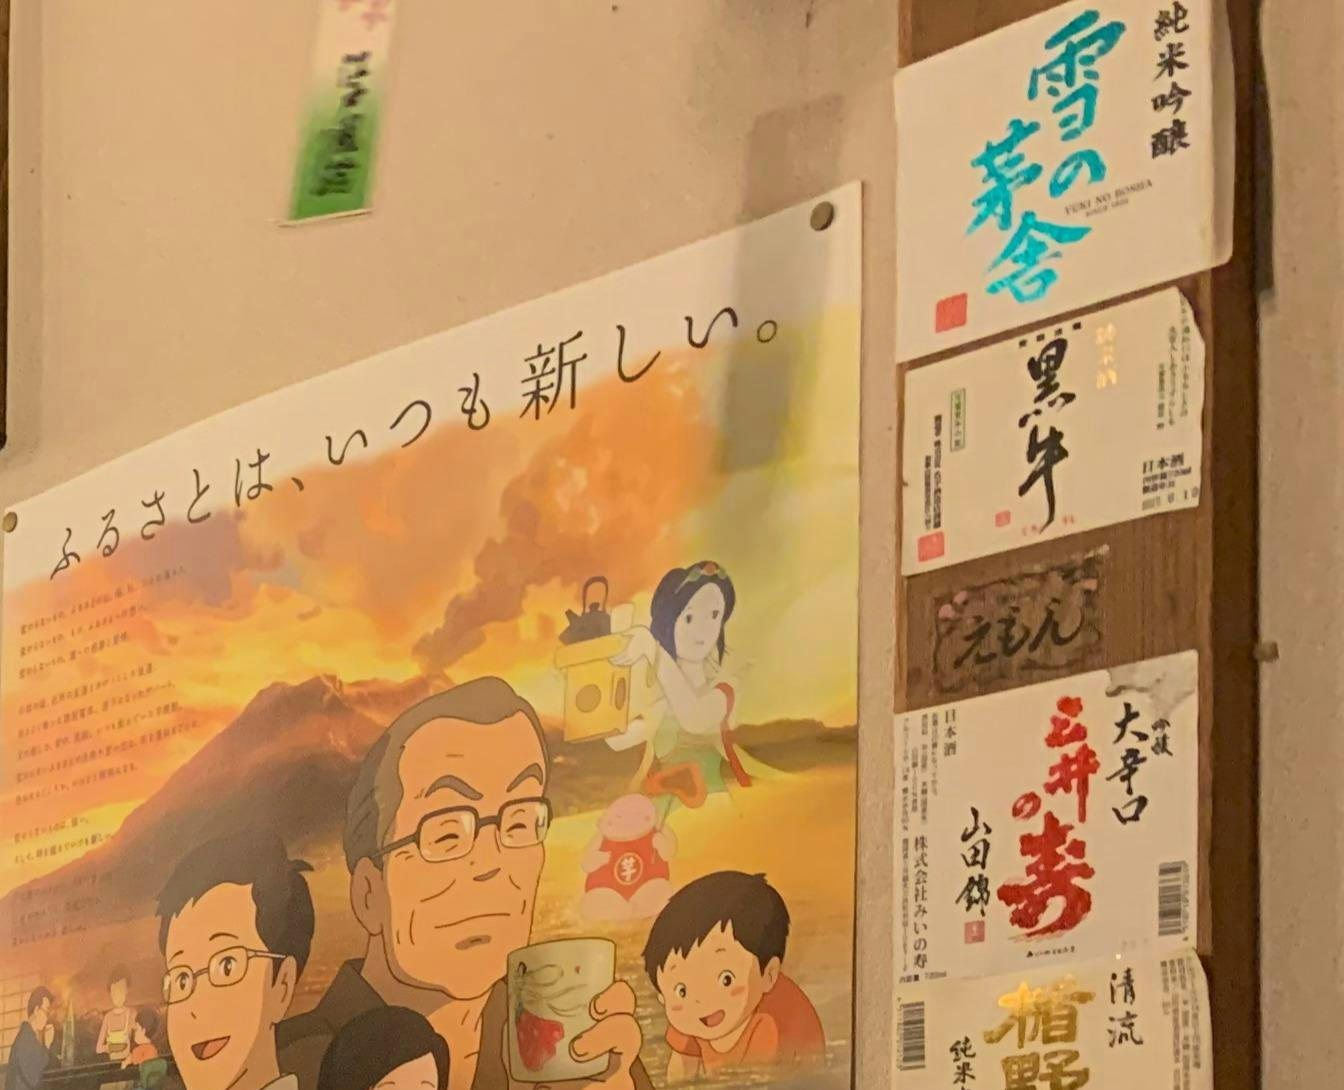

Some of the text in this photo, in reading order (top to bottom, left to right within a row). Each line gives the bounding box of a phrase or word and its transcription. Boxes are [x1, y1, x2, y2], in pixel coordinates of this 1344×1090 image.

[944, 709, 957, 756] 日本酒
[1106, 702, 1149, 825] 大辛口
